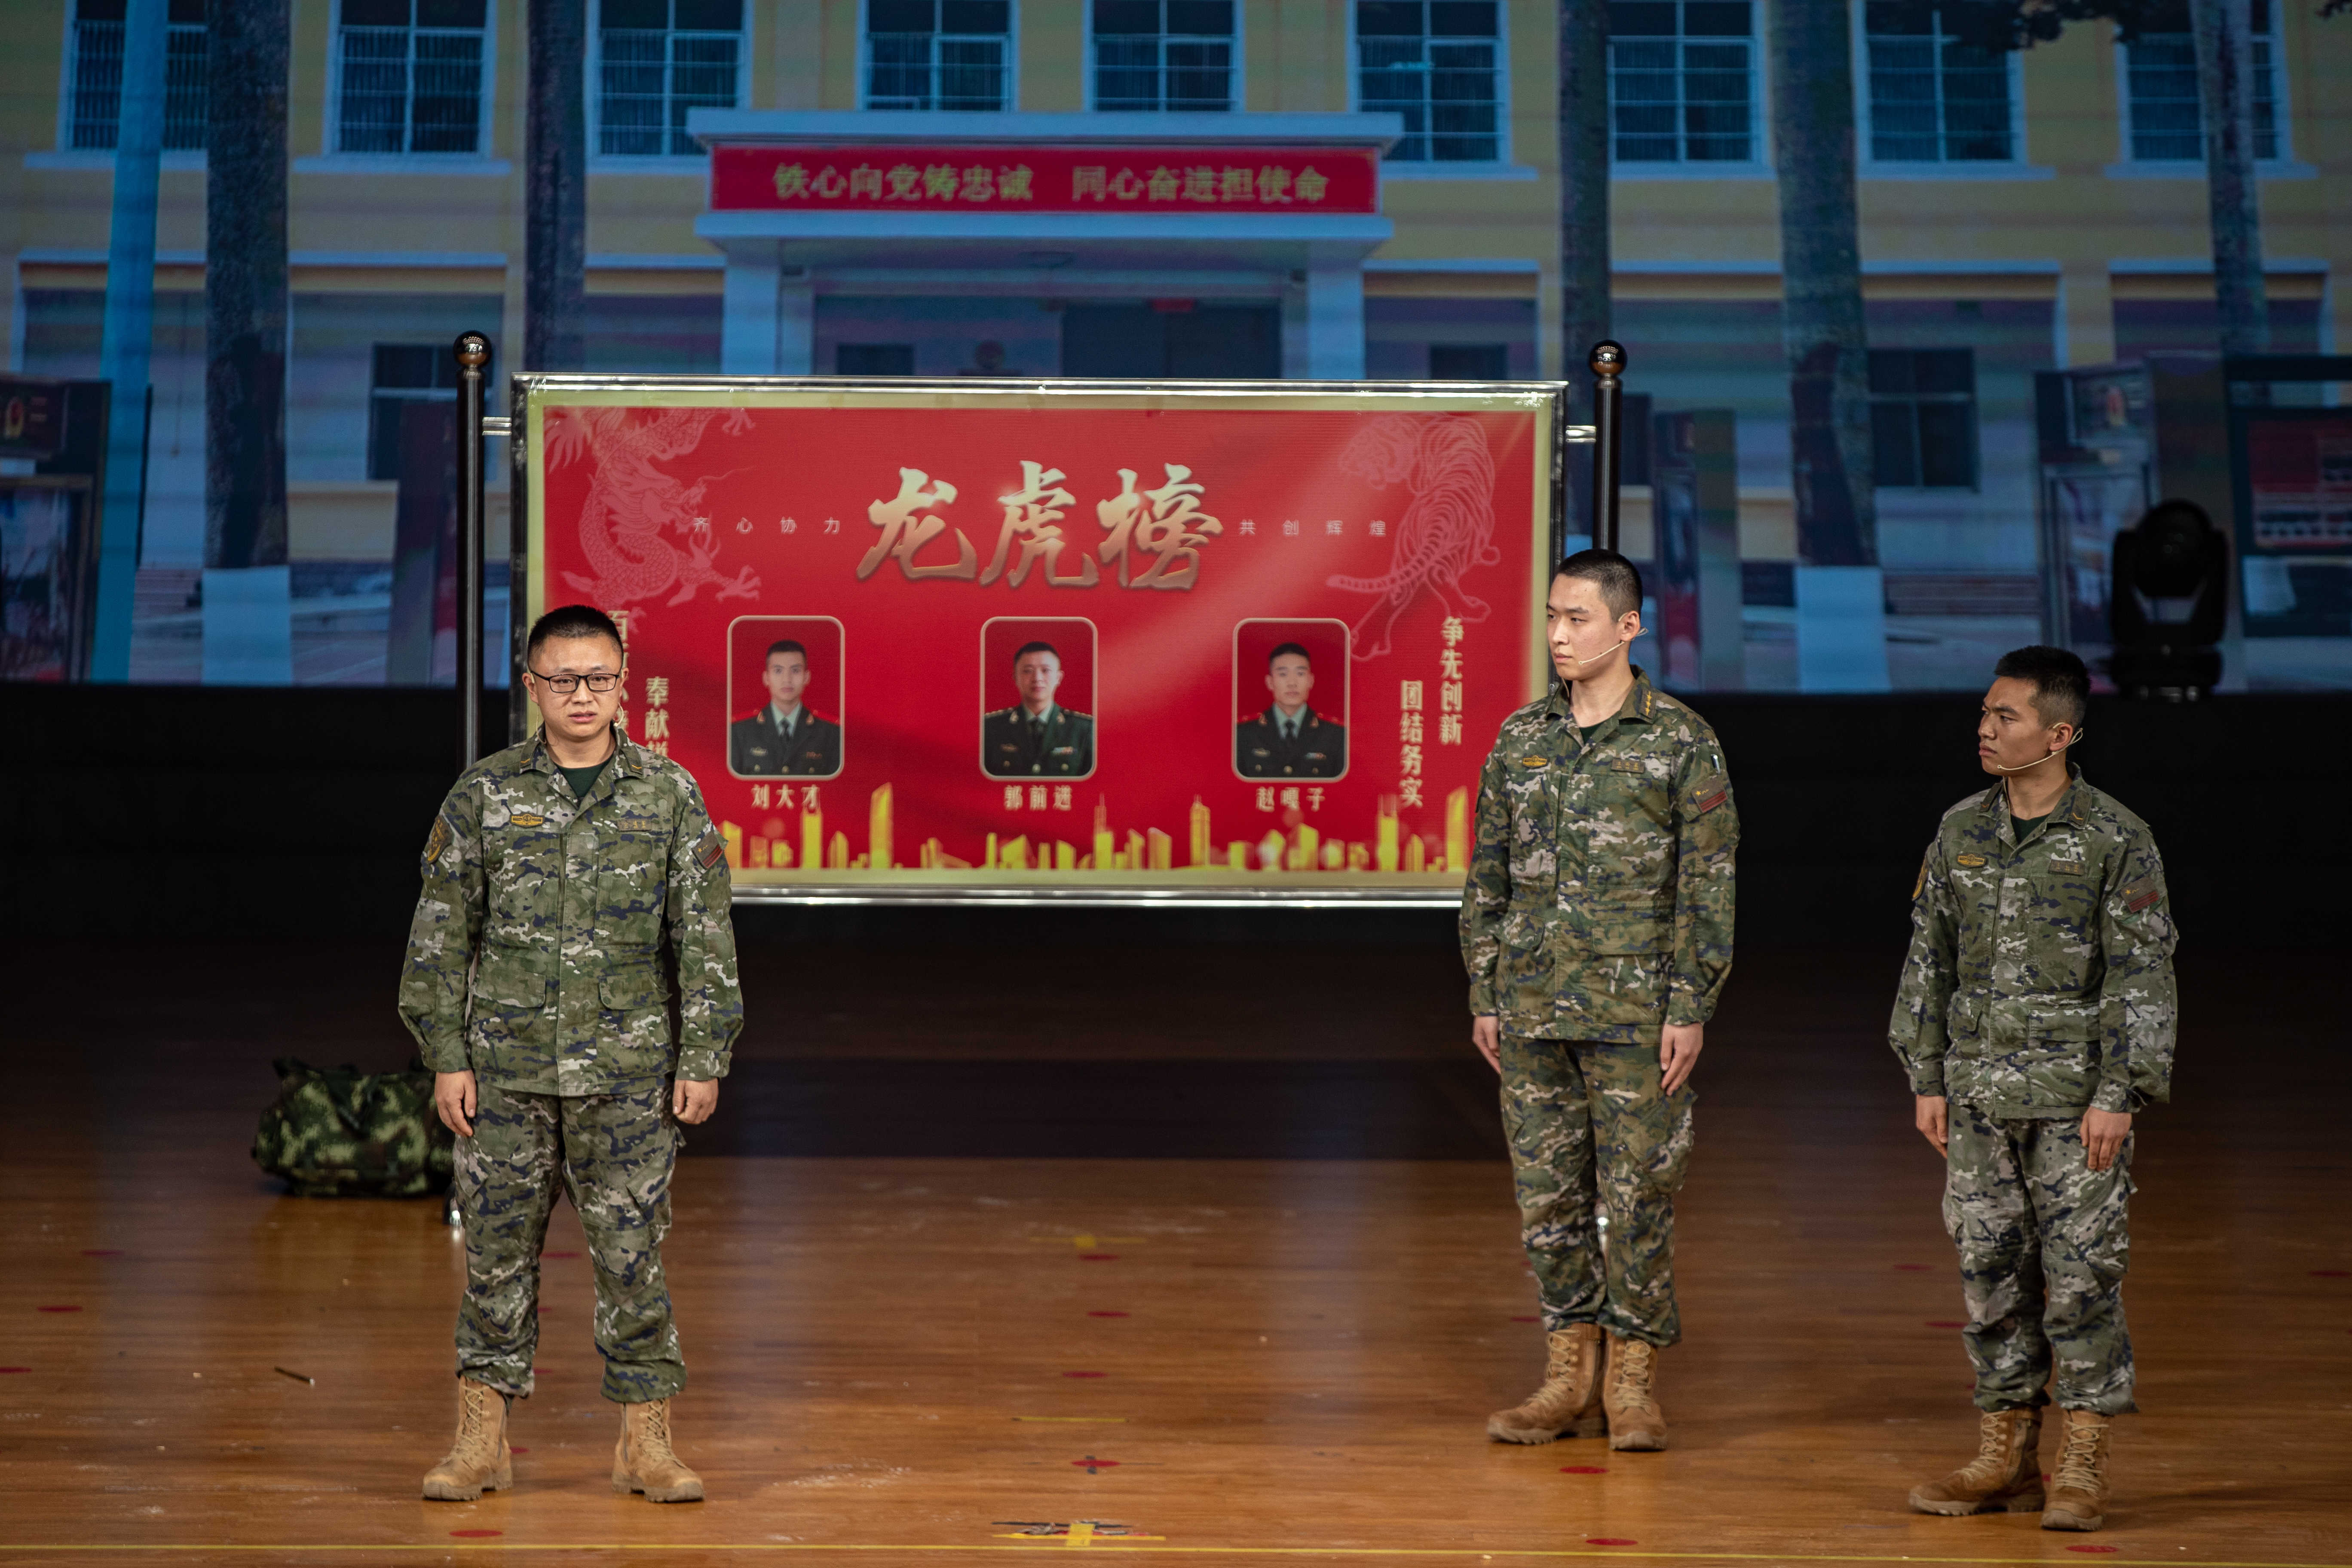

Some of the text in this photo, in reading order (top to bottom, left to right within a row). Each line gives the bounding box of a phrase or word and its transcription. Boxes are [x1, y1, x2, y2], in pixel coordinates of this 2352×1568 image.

[773, 163, 1329, 202] 铁心向党铸忠诚 同心奋进担使命
[694, 517, 840, 534] 齐心协力
[856, 460, 1224, 591] 龙虎榜
[1239, 519, 1386, 536] 共创辉煌
[1439, 616, 1464, 746] 争先创新
[1399, 680, 1424, 808] 团结务实
[751, 784, 820, 810] 刘大才
